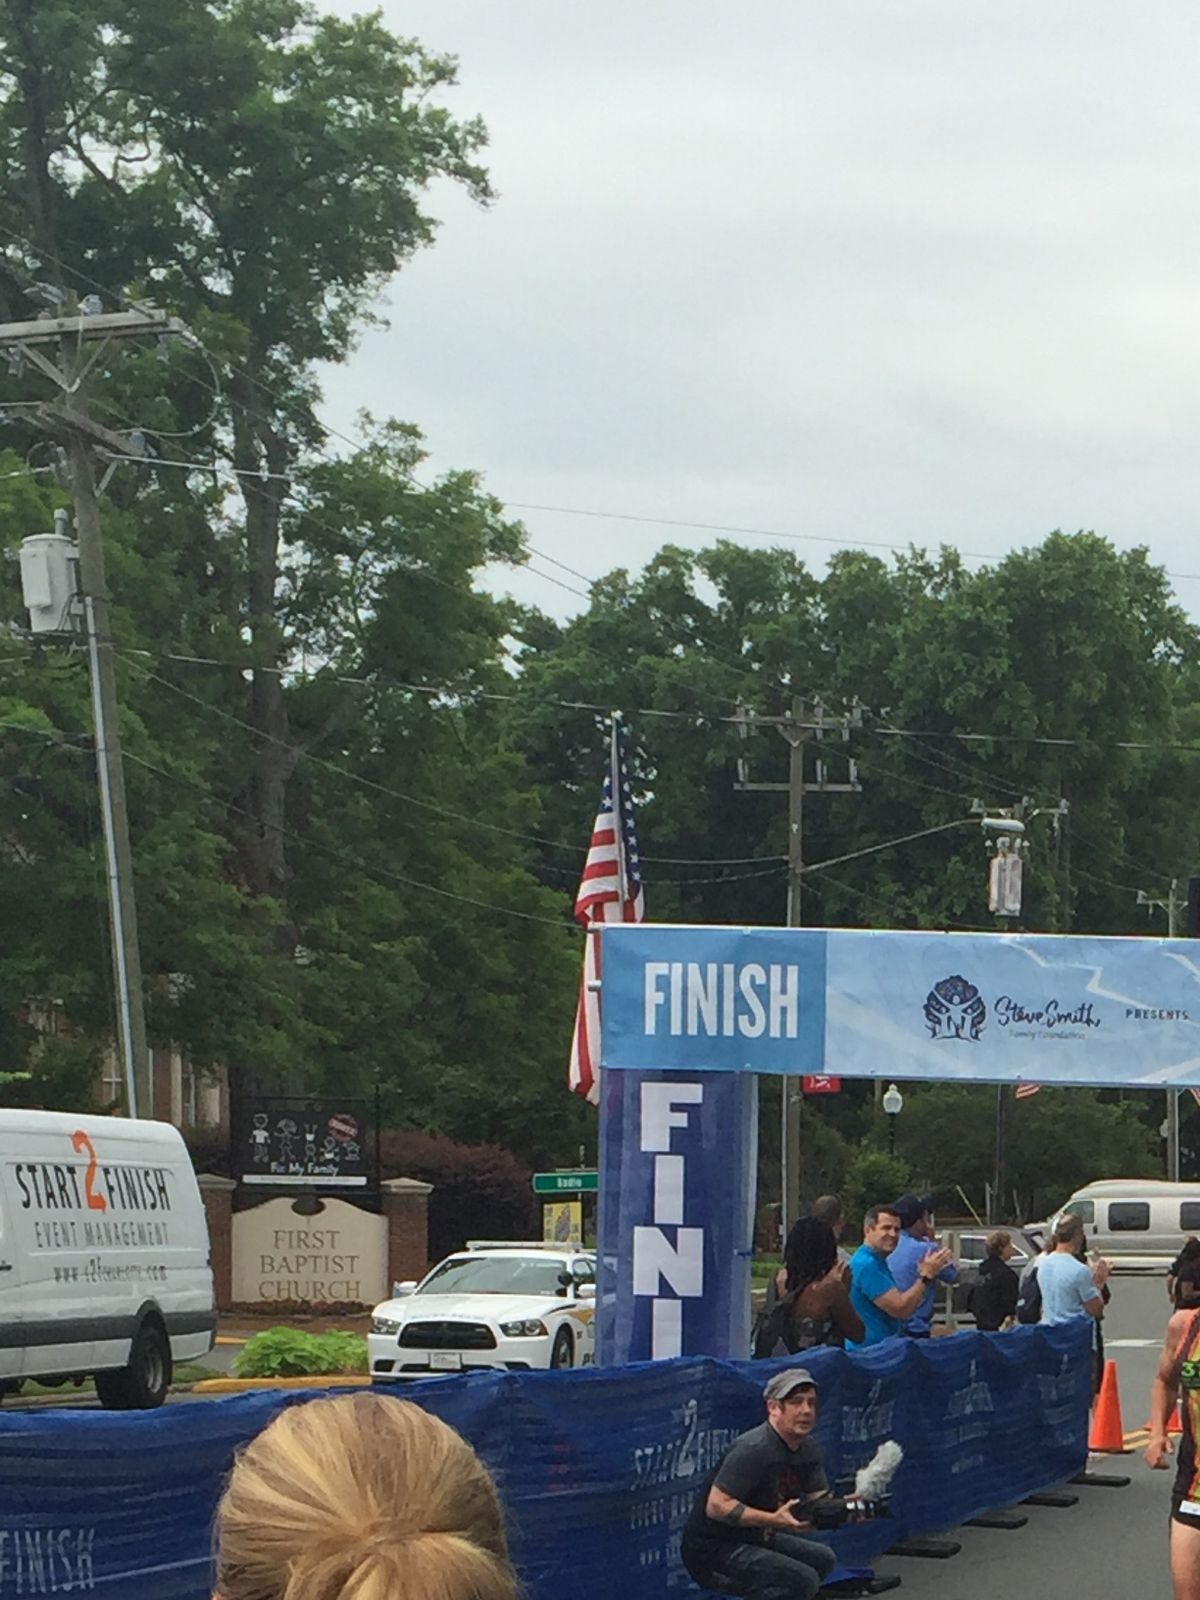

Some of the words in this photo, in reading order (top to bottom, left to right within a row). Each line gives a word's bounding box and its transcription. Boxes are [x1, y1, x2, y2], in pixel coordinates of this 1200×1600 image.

[644, 961, 798, 1039] FINISH
[994, 995, 1043, 1028] Steve
[1125, 1008, 1190, 1021] PRESENTS
[15, 1164, 82, 1209] START
[72, 1130, 107, 1213] 2
[102, 1166, 172, 1211] FINISH
[34, 1221, 78, 1249] EVENT
[83, 1221, 169, 1248] MANAGEMENT
[273, 1229, 341, 1250] FIRST
[259, 1254, 360, 1275] BAPTIST
[258, 1280, 361, 1301] CHURCH
